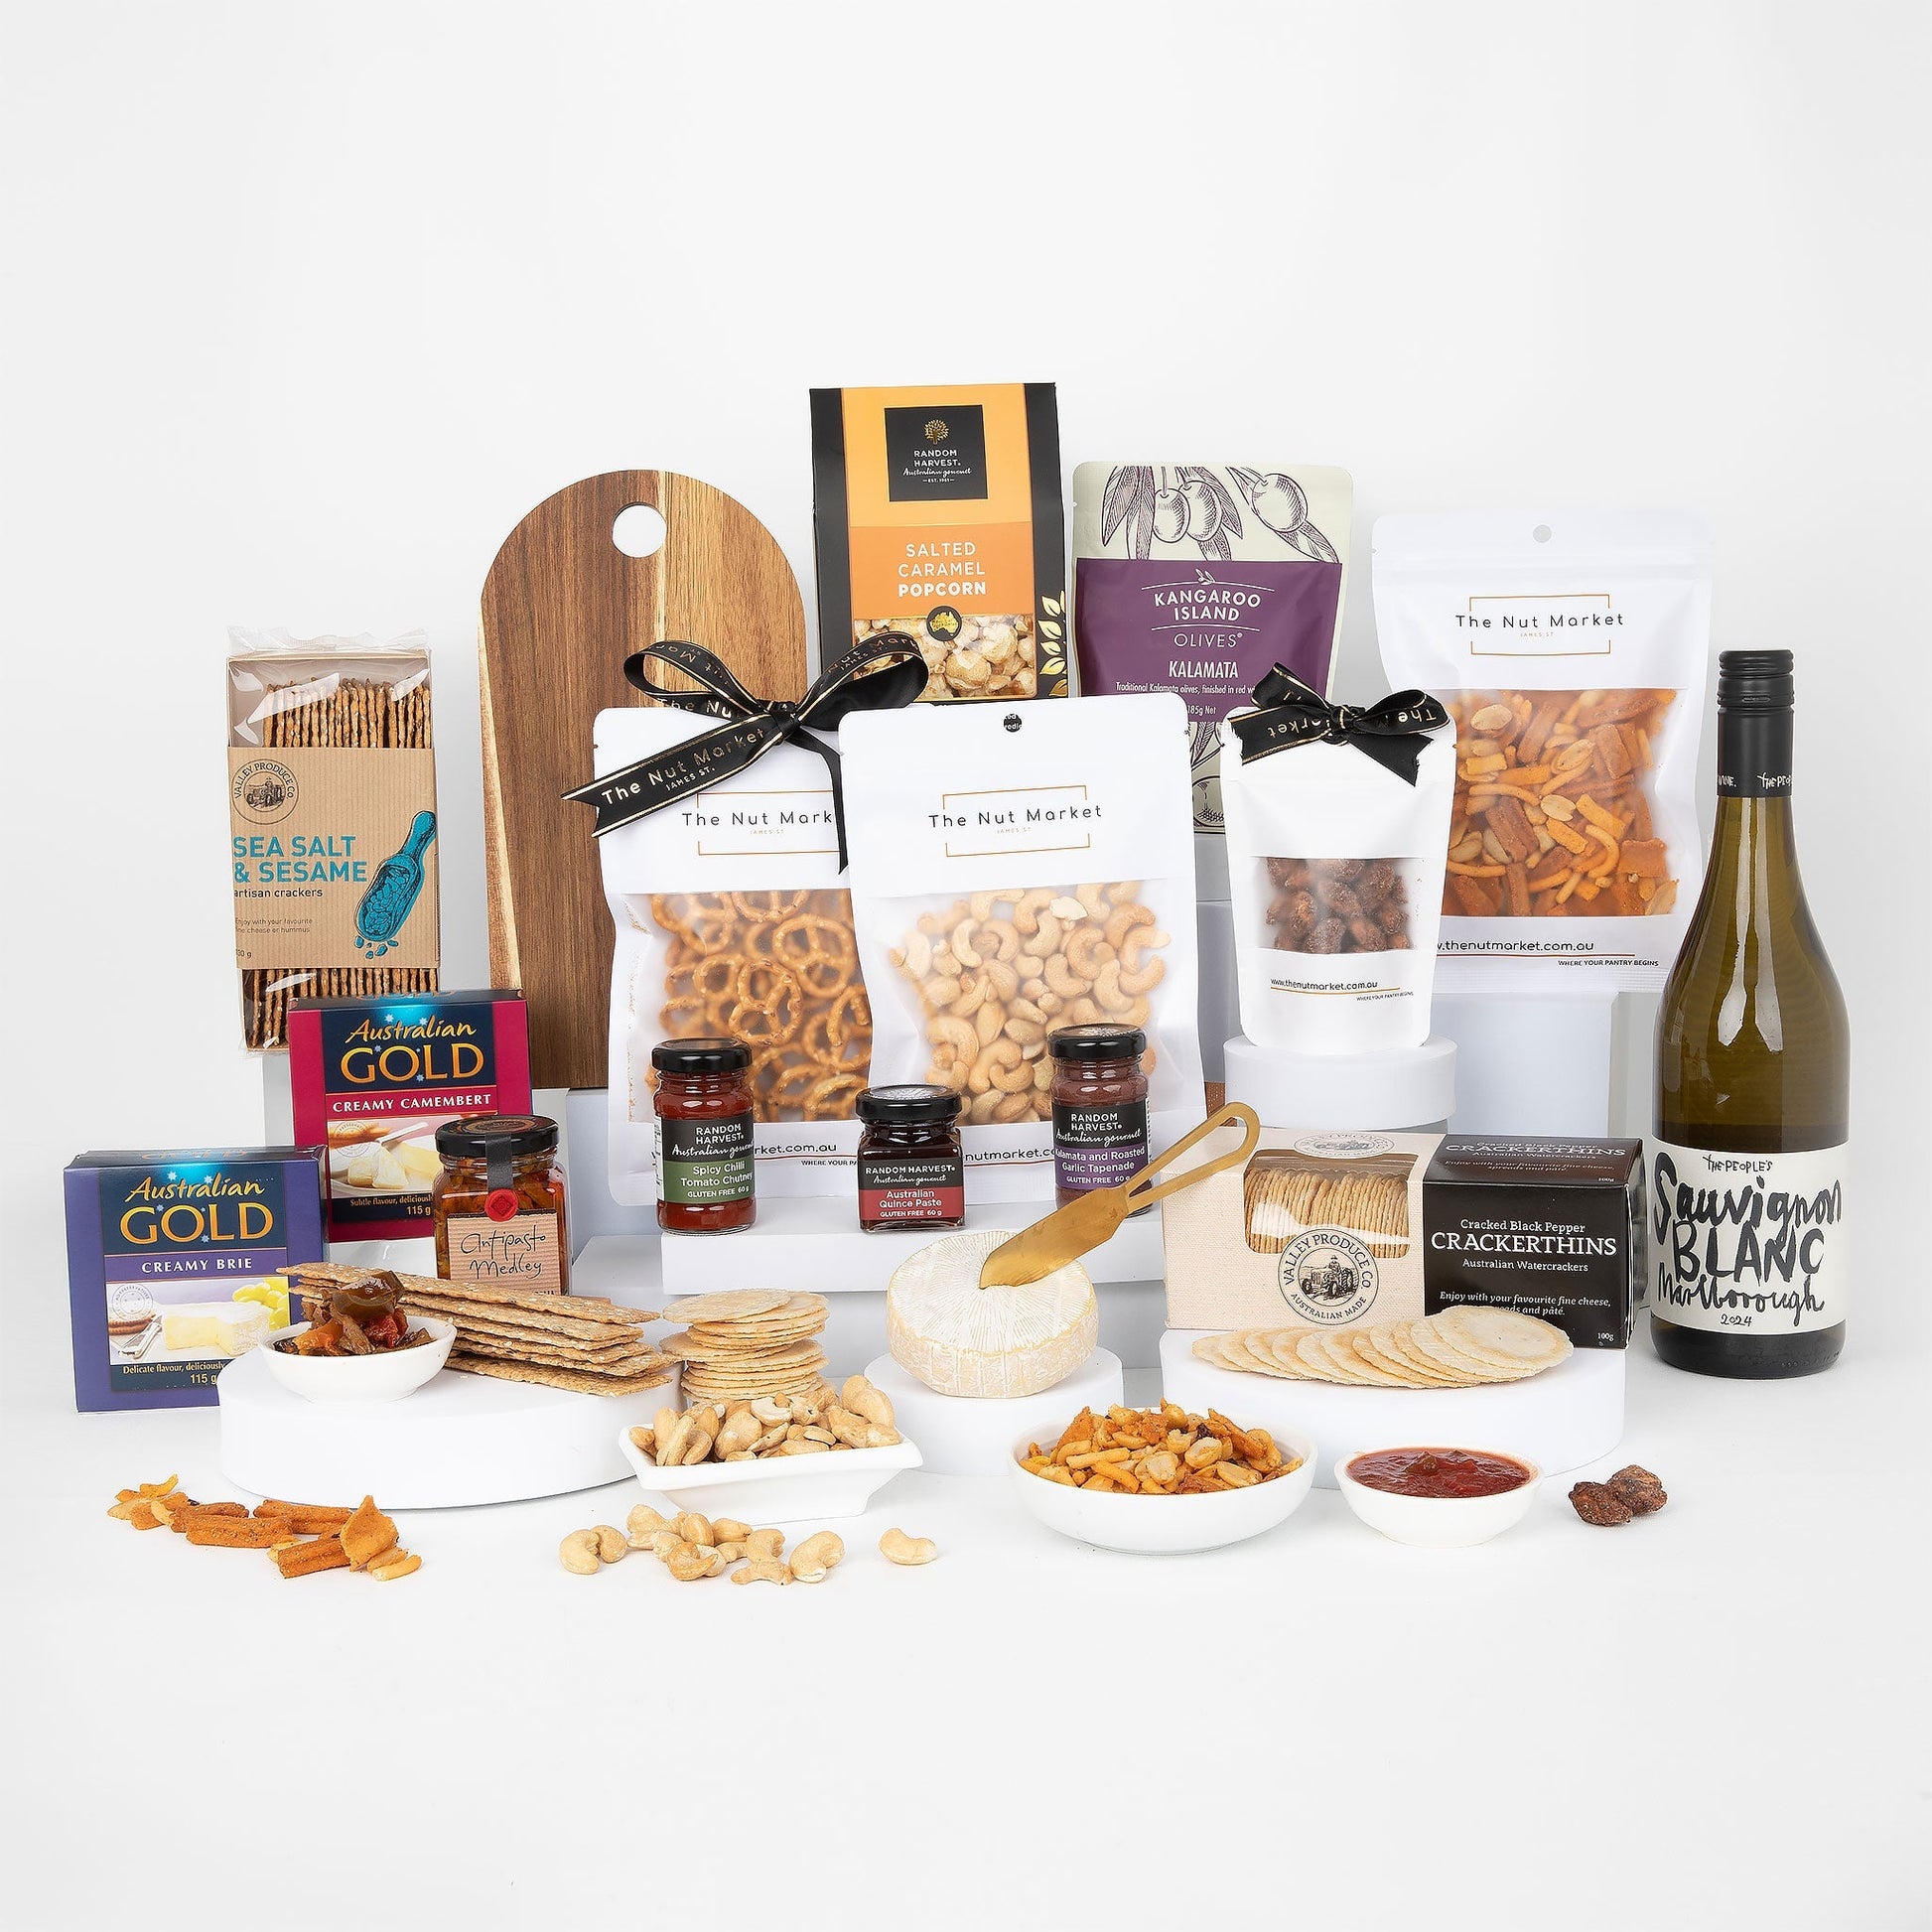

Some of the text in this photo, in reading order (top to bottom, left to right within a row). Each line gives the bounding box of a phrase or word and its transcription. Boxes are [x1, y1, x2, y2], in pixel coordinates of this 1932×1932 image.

[905, 542, 976, 557] SALTED
[897, 562, 985, 578] CARAMEL
[897, 582, 987, 598] POPCORN
[1154, 590, 1261, 608] KANGAROO
[1174, 606, 1240, 621] ISLAND
[1455, 614, 1624, 627] The Nut Market
[1170, 661, 1238, 679] KALAMATA
[1116, 681, 1245, 695] Traditional Kalamata olives, finished in red
[1187, 705, 1216, 717] 185g Net
[1398, 708, 1438, 723] The
[1268, 719, 1321, 739] arket
[602, 727, 764, 806] The Nut Market
[234, 764, 253, 798] VALLEY
[254, 762, 294, 785] PRODUCE
[665, 765, 716, 792] JAMES ST.
[682, 810, 832, 826] The Nut Mark
[928, 804, 1102, 828] The Nut Market
[232, 836, 355, 858] SEA SALT
[234, 861, 367, 883] & SESAME
[234, 888, 324, 898] artisan crackers
[1271, 978, 1378, 991] www.thenutmarket.com.au
[345, 1015, 477, 1042] Australian
[341, 1043, 484, 1084] GOLD
[333, 1094, 491, 1113] CREAMY CAMEMBERT
[1070, 1112, 1118, 1122] RANDOM
[696, 1124, 741, 1136] RANDOM
[1056, 1128, 1103, 1142] Australian
[671, 1144, 729, 1158] Australian
[1088, 1146, 1145, 1162] and Roasted
[1446, 1146, 1626, 1156] CRACKERTHINS
[693, 1161, 745, 1175] Spicy Chilli
[1062, 1162, 1134, 1173] Garlic Tapenade
[681, 1172, 753, 1187] Tomato Chutney
[874, 1174, 913, 1183] Australian
[125, 1173, 266, 1202] Australian
[886, 1189, 935, 1199] Australian
[349, 1197, 371, 1207] Subtle
[880, 1199, 913, 1209] Quince
[1654, 1152, 1843, 1247] Sauvignon
[407, 1205, 431, 1215] 115 g
[120, 1202, 274, 1245] GOLD
[1460, 1219, 1586, 1235] Cracked Black Pepper
[461, 1225, 546, 1261] Antipasto
[1432, 1231, 1617, 1256] CRACKERTHINS
[1284, 1237, 1311, 1286] VALLEY
[1312, 1233, 1370, 1273] PRODUCE
[1672, 1219, 1825, 1287] BLANC
[142, 1258, 252, 1273] CREAMY BRIE
[469, 1253, 542, 1279] Medley
[1462, 1259, 1588, 1272] Australian Watercrackers
[1291, 1293, 1367, 1319] AUSTRALIAN MADE
[1440, 1291, 1611, 1308] Enjoy with your favourite fine cheese,
[1542, 1307, 1566, 1316] pâté.
[1720, 1313, 1753, 1326] 2024
[1597, 1332, 1614, 1341] 100g
[123, 1365, 155, 1374] Delicate
[157, 1363, 184, 1372] flavour,
[191, 1374, 217, 1385] 115 g
